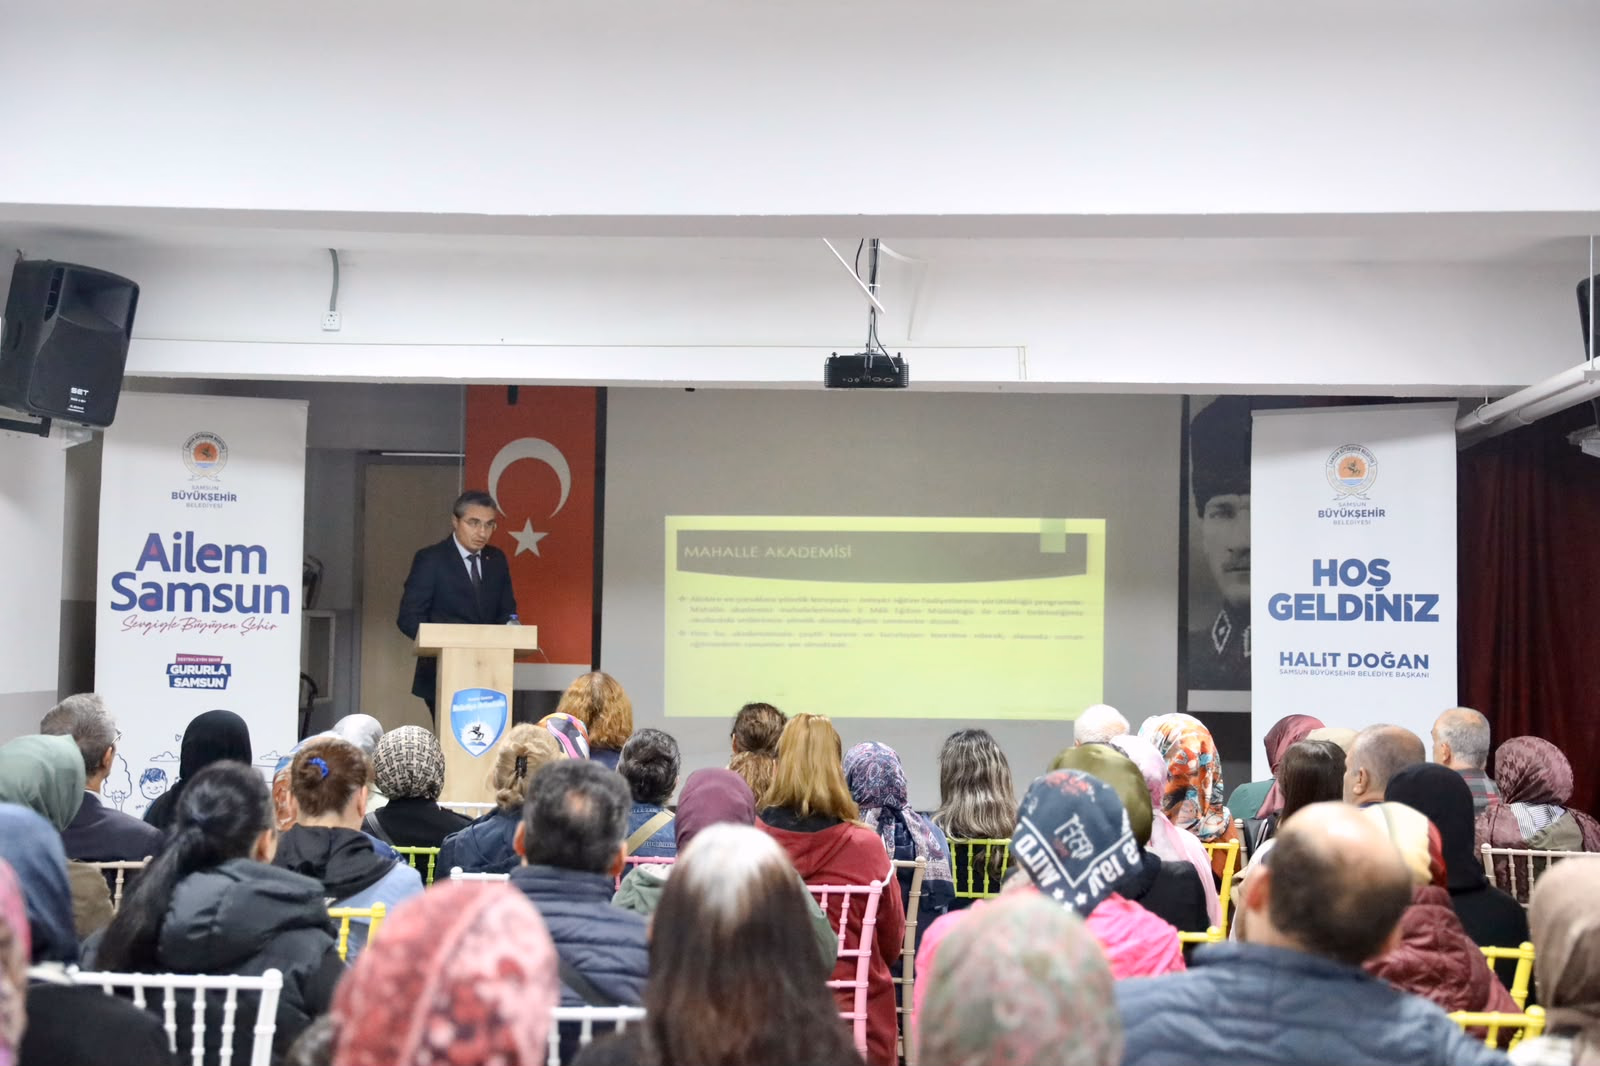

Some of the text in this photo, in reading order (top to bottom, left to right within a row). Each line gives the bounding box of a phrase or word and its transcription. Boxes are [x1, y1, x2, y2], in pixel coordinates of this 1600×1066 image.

[171, 490, 237, 502] BÜYÜKŞEHİR
[1318, 507, 1386, 519] BÜYÜKŞEHİR
[135, 531, 267, 574] Ailem
[684, 544, 852, 559] MAHALLE AKADEMİSİ
[1312, 558, 1392, 591] HOŞ
[110, 572, 290, 614] Samsun
[1268, 592, 1439, 622] GELDİNİZ
[121, 614, 279, 636] Sevgiyle Büyüyen Şehir
[1347, 651, 1429, 669] DOĞAN
[170, 664, 227, 676] GURURLA
[173, 677, 224, 688] SAMSUN
